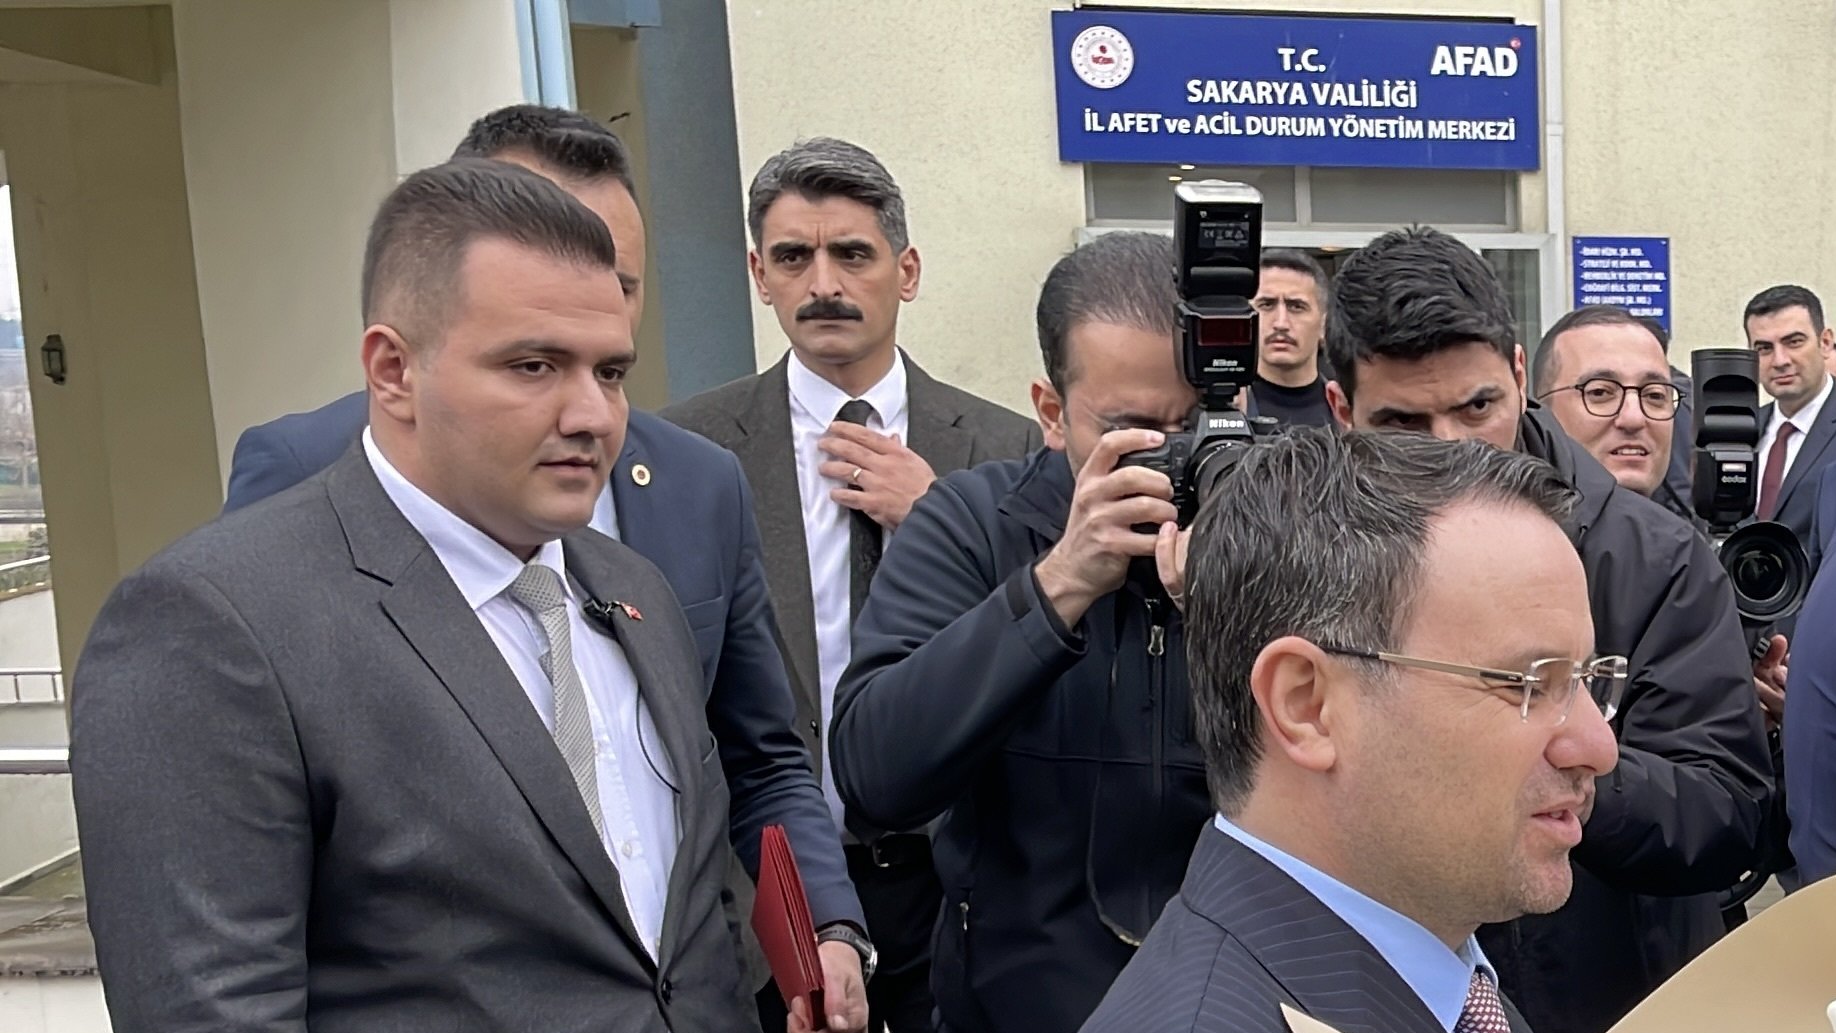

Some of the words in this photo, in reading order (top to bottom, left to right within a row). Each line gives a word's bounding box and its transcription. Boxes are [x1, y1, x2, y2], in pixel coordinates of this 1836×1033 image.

[1277, 47, 1326, 72] T.C.
[1430, 45, 1518, 77] AFAD
[1186, 79, 1309, 105] SAKARYA
[1310, 79, 1417, 108] VALİLİĞİ
[1084, 107, 1105, 132] İL
[1107, 112, 1162, 133] AFET
[1164, 118, 1191, 134] ve
[1194, 111, 1243, 135] ACİL
[1245, 115, 1326, 137] DURUM
[1328, 114, 1424, 139] YÖNETİM
[1427, 117, 1516, 141] MERKEZİ
[1212, 358, 1239, 367] Nikon
[1209, 418, 1245, 429] Nikon
